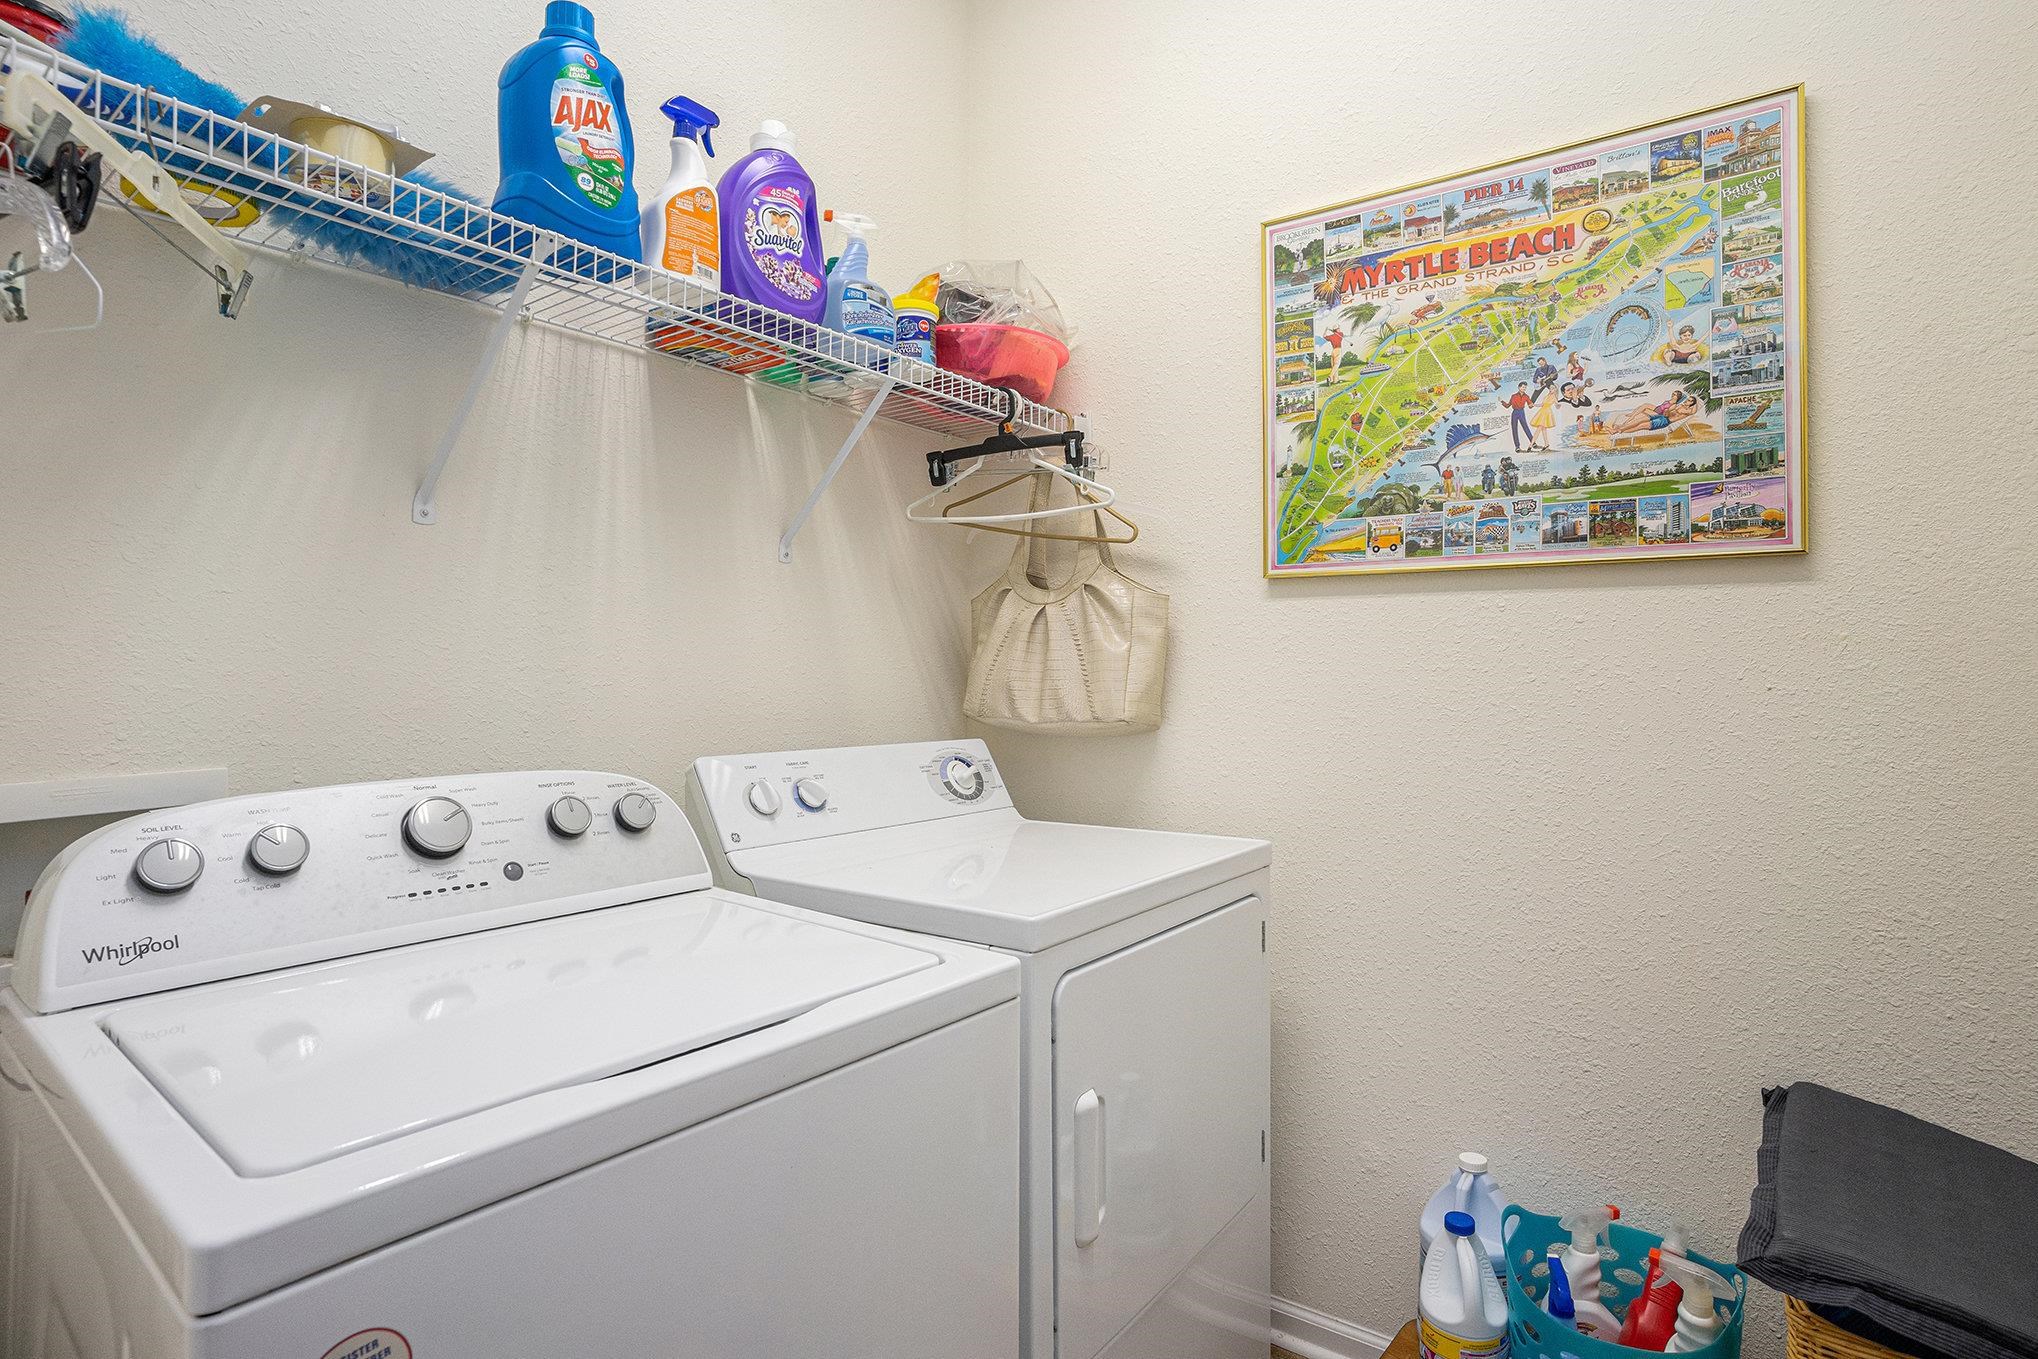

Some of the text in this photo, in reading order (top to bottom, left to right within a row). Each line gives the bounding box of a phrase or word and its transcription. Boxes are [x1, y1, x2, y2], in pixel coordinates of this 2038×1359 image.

[553, 95, 612, 133] AJAX
[1708, 126, 1731, 138] IMAX
[1555, 160, 1596, 174] VINEYARD
[581, 176, 592, 185] 89
[1722, 168, 1781, 198] Barefoot
[770, 188, 781, 197] 45
[1464, 183, 1503, 203] PIER
[1508, 177, 1524, 192] 14
[754, 229, 803, 255] Suavitel
[1341, 223, 1576, 295] MYRTLE BEACH
[1341, 294, 1354, 304] &
[1361, 288, 1389, 300] THE
[1397, 276, 1457, 294] GRAND
[1729, 396, 1757, 405] APACHE
[141, 824, 183, 834] SOIL LEVEL
[96, 873, 117, 881] Light
[114, 896, 135, 905] Light
[82, 934, 180, 966] Whirlpool
